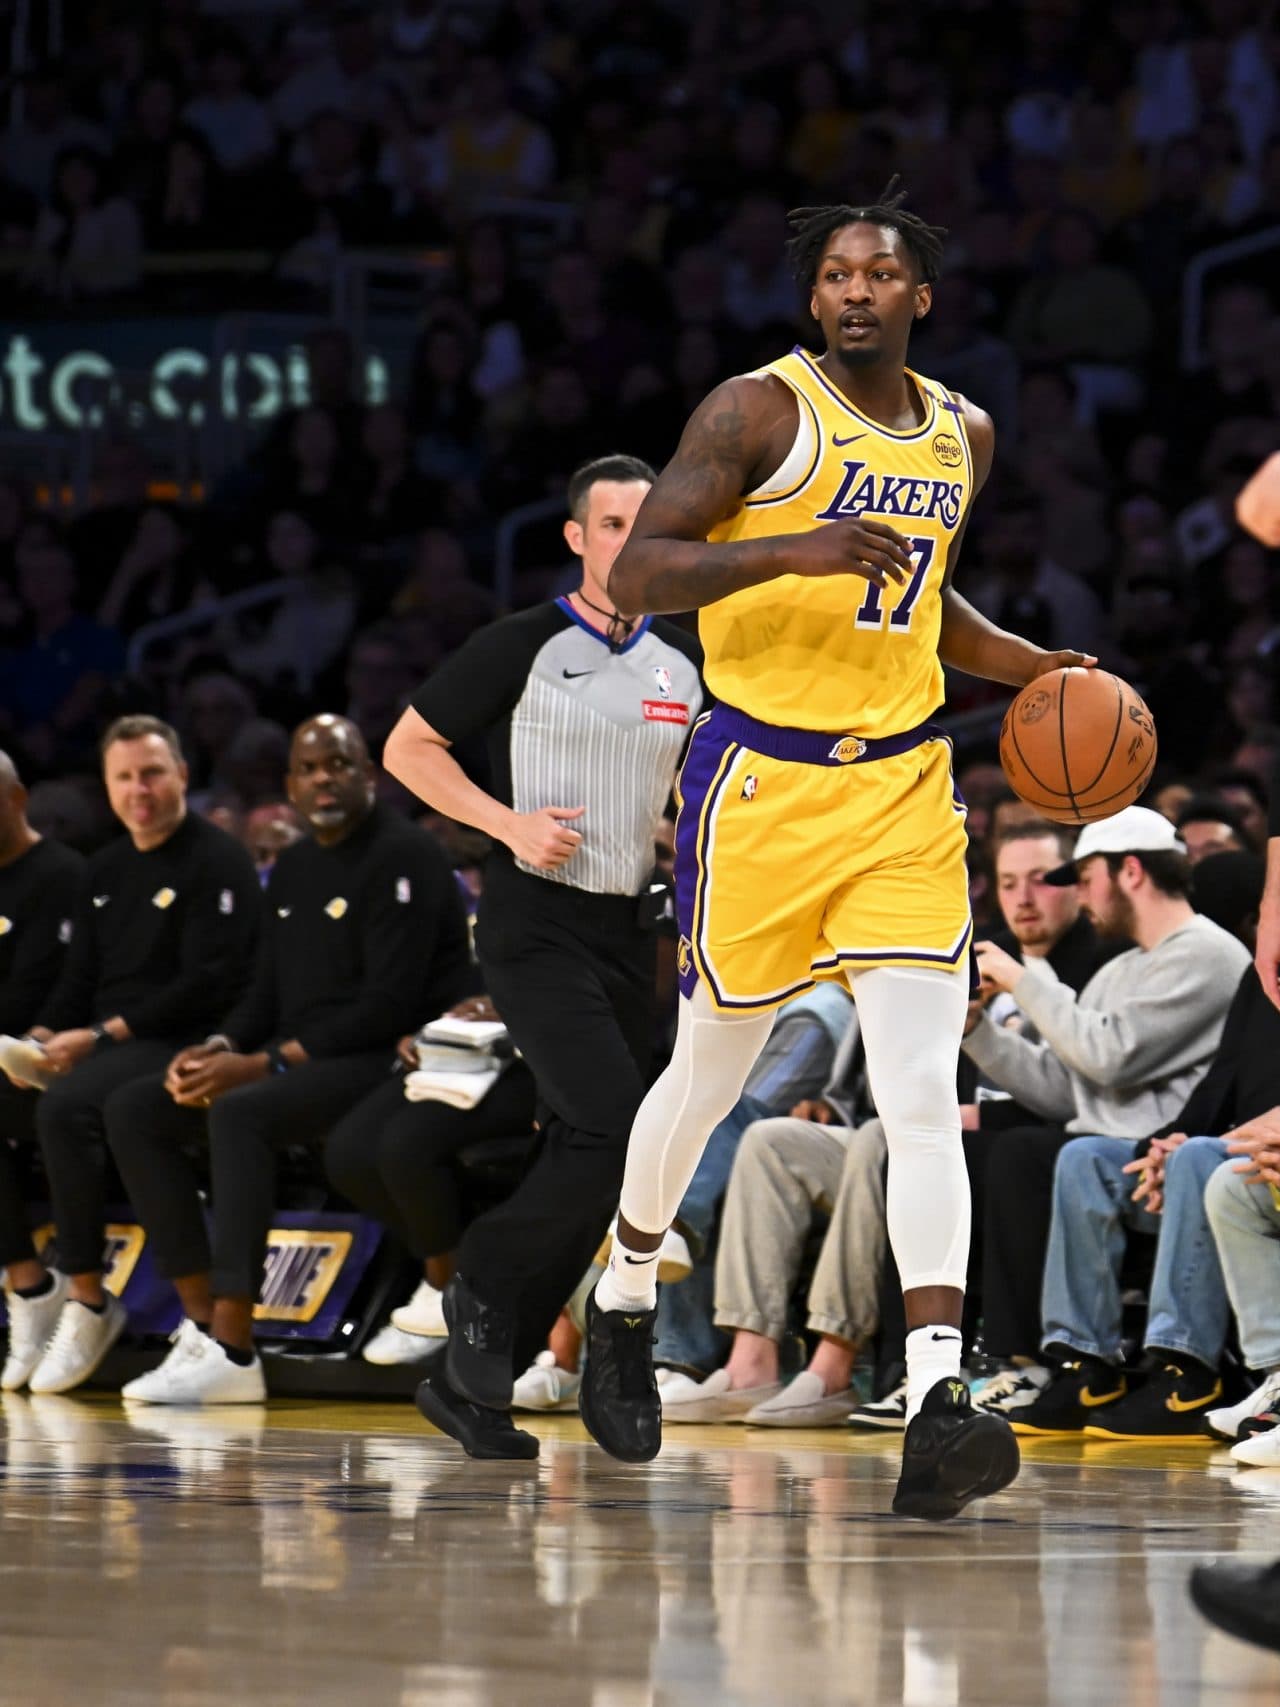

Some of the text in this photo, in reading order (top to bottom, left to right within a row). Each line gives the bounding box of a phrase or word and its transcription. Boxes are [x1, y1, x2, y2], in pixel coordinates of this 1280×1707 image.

[935, 442, 961, 458] bibigo
[814, 460, 964, 530] LAKERS
[854, 536, 937, 632] 17
[644, 703, 688, 721] Emirates
